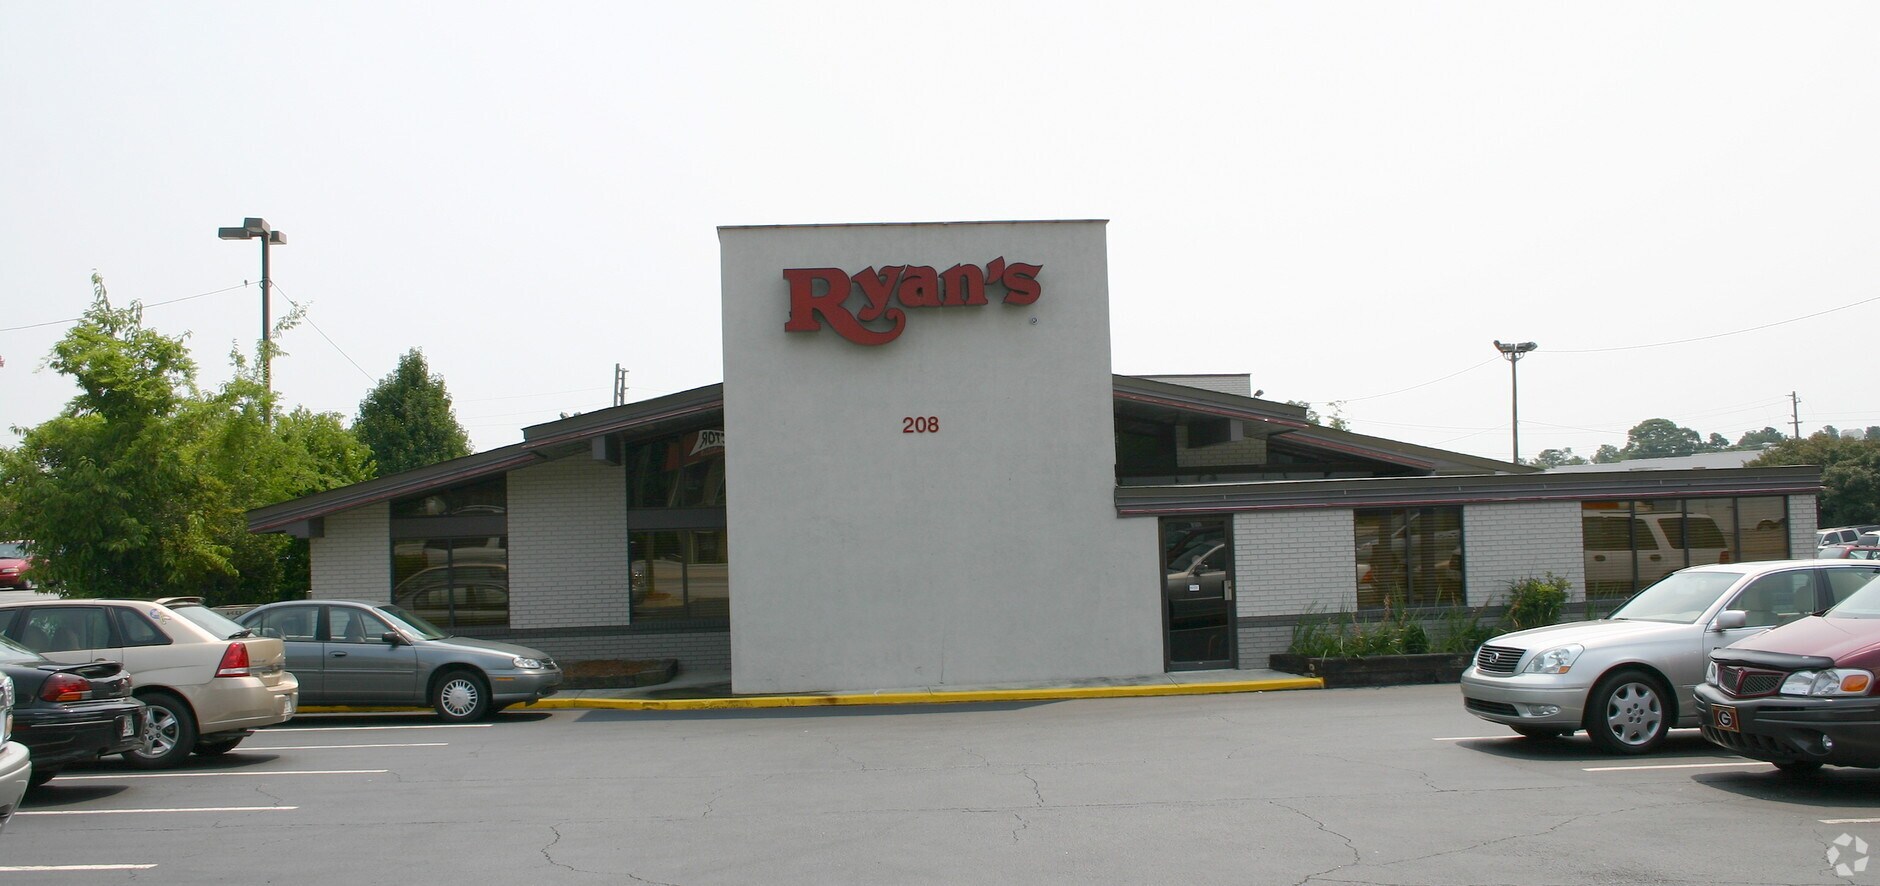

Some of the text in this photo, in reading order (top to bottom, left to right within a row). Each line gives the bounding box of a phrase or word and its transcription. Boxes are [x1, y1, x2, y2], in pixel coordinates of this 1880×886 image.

[783, 256, 1043, 346] Ryan's
[902, 416, 940, 433] 208
[1718, 710, 1732, 727] G
